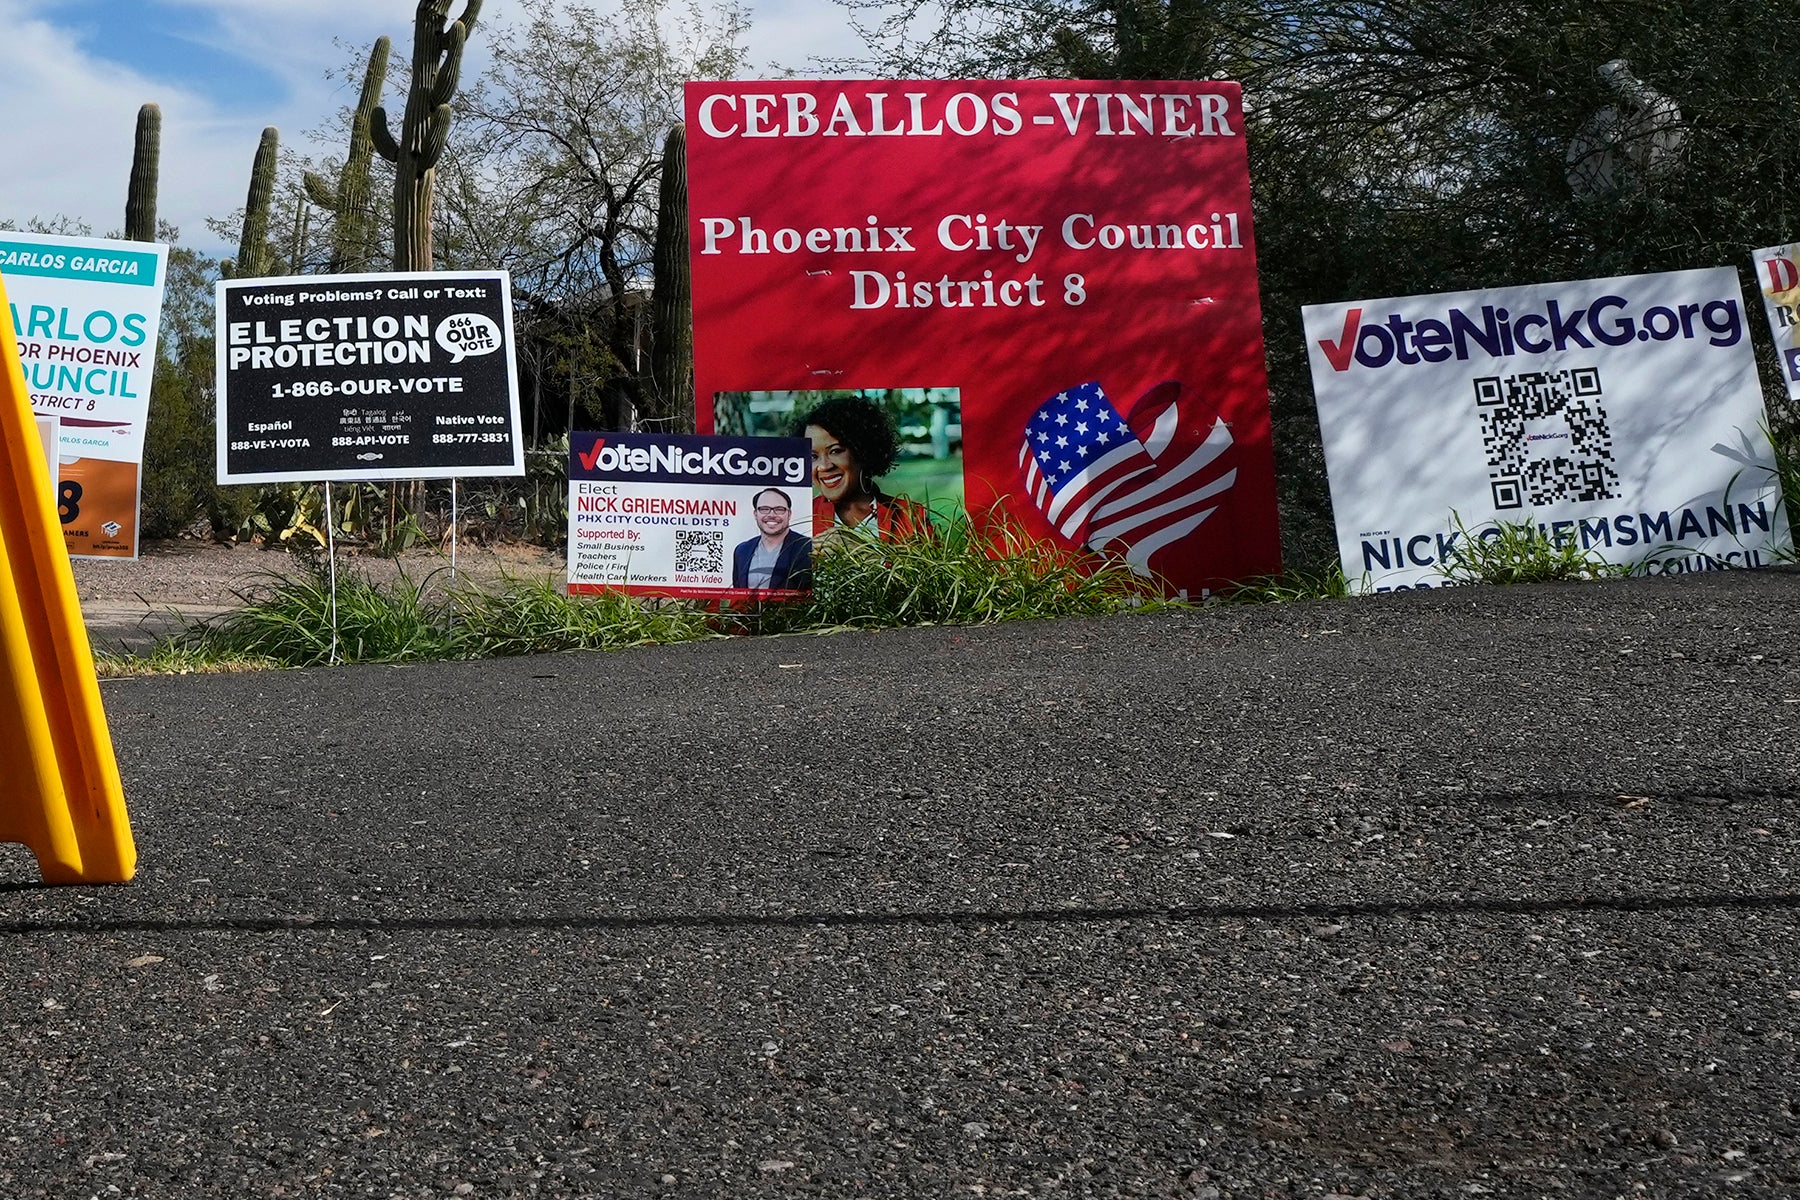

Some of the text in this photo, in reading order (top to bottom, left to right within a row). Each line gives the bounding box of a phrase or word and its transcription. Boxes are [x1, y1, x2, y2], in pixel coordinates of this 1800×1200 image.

[700, 212, 1244, 263] Phoenix City Council
[70, 256, 139, 275] GARCIA
[849, 268, 1086, 310] District 8
[242, 286, 487, 306] Voting Problems? Call or Text:
[449, 316, 472, 327] 866
[229, 314, 429, 345] ELECTION
[446, 325, 490, 343] OUR
[458, 339, 495, 351] VOTE
[17, 342, 141, 368] OR PHOENIX
[229, 340, 431, 370] PROTECTION
[271, 377, 464, 398] 1-866-OUR-VOTE
[29, 394, 95, 411] STRICT 8
[361, 409, 387, 417] Tagalog
[248, 420, 292, 433] Español
[436, 415, 505, 426] Native Vote
[230, 438, 310, 450] 888-VE-Y-VOTA
[332, 435, 409, 446] 888-API-VOTE
[432, 433, 510, 444] 888-777-3831
[579, 483, 617, 495] Elect
[577, 497, 737, 516] NICK GRIEMSMANN
[577, 514, 730, 527] PHX CITY COUNCIL DIST 8
[577, 528, 641, 541] Supported By:
[577, 542, 645, 551] Small Business
[1361, 531, 1464, 571] NICK
[577, 552, 617, 561] Teachers
[577, 562, 604, 571] Police
[611, 563, 628, 571] Fire
[576, 572, 667, 582] Health Care Workers
[675, 574, 723, 584] Watch Video
